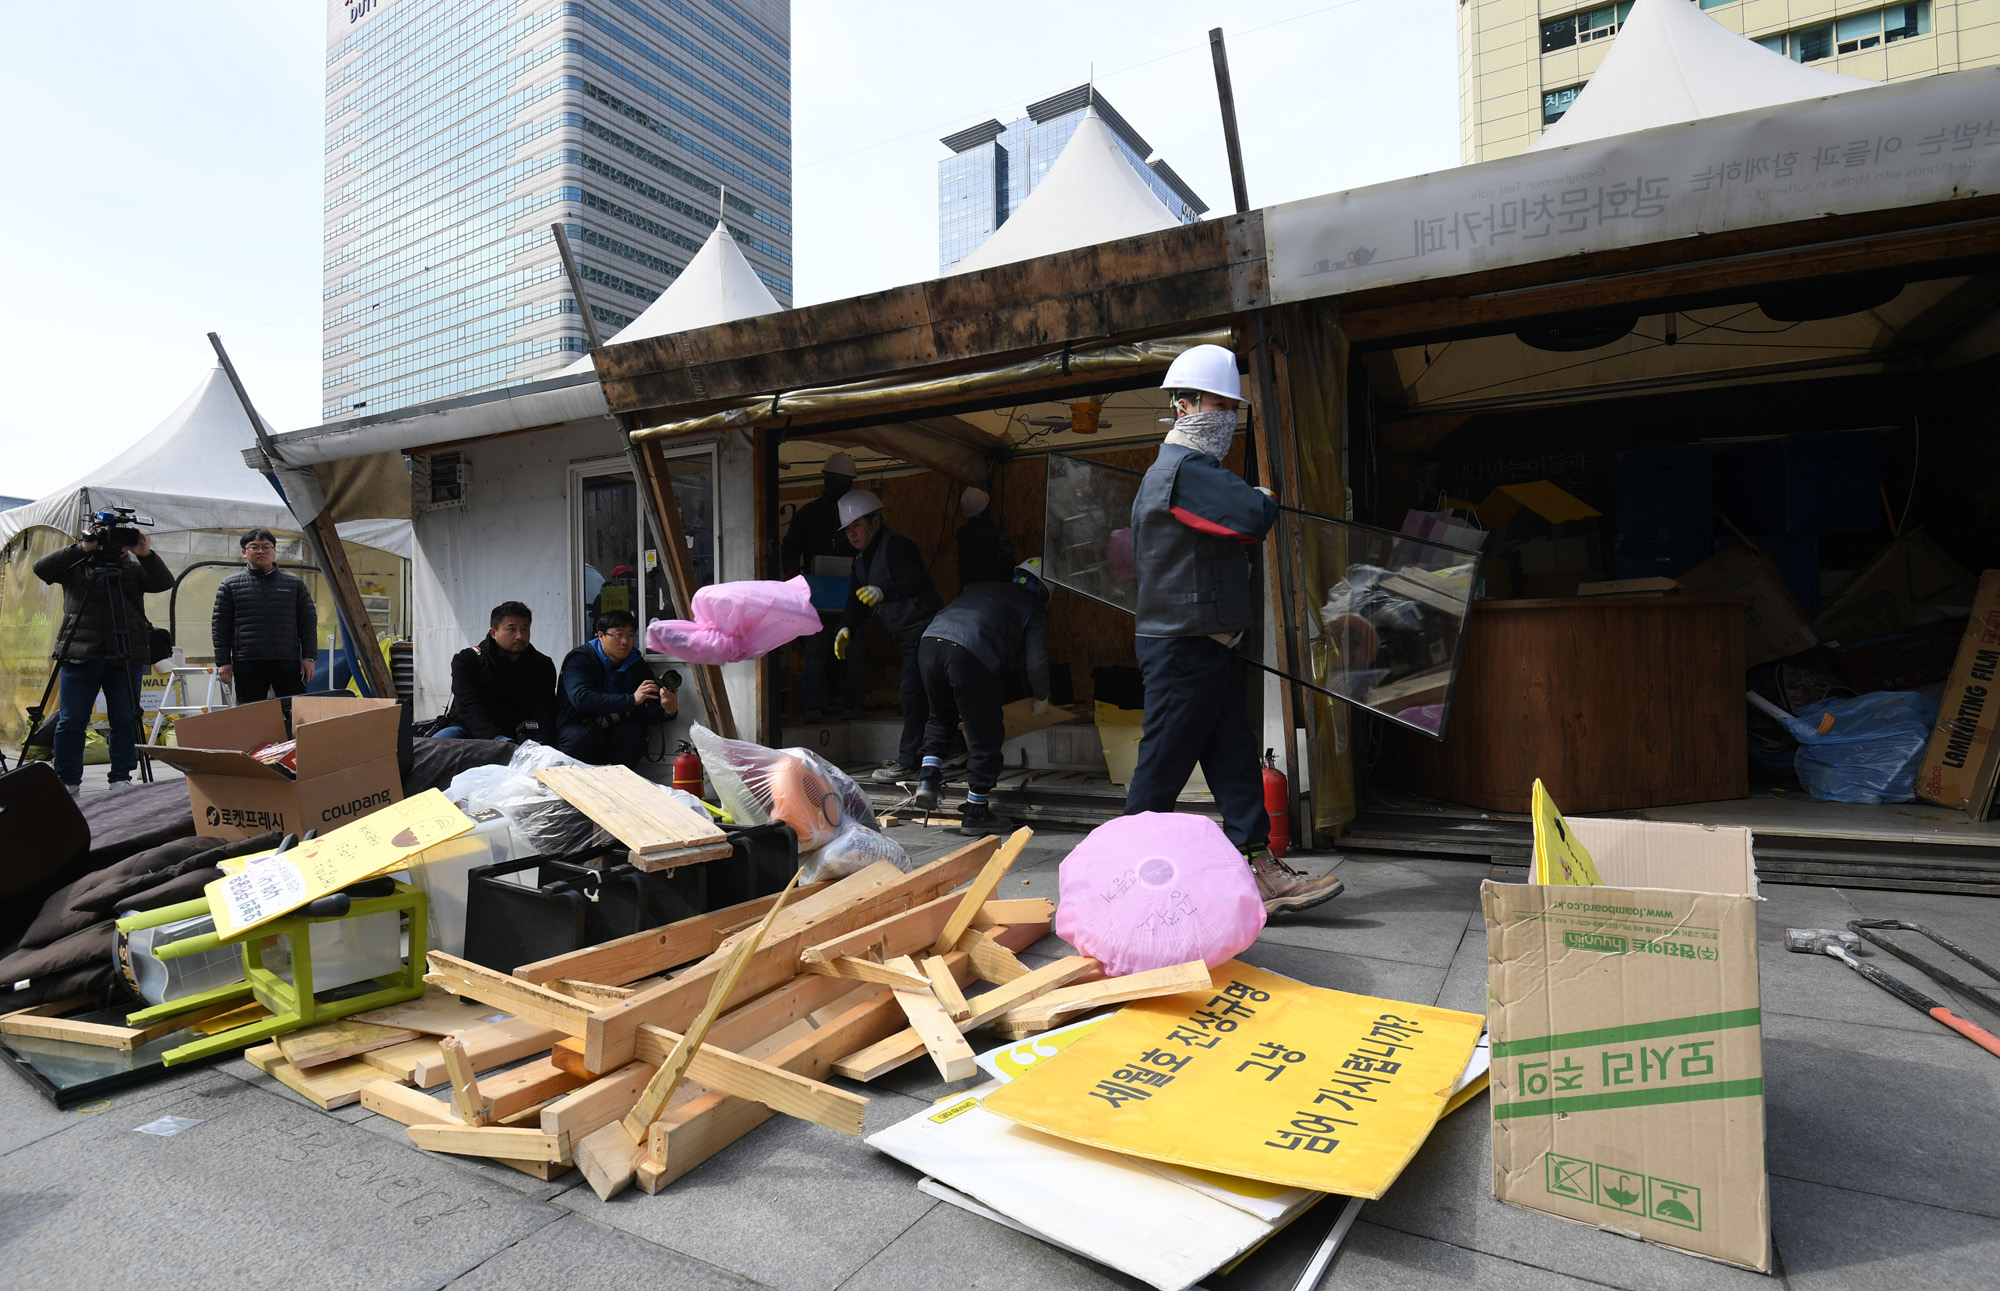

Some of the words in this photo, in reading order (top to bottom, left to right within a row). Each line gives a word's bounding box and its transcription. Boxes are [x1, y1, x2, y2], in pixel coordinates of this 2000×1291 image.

[1545, 88, 1576, 108] 치과
[1971, 649, 2000, 682] FILM
[221, 808, 284, 831] 로켓프레시
[321, 788, 391, 822] coupang
[1554, 900, 1673, 919] www.foamboard.co.kr
[1568, 932, 1622, 951] hyunjin
[1088, 1048, 1193, 1108] 세월호
[1166, 980, 1271, 1049] 진상규명
[1235, 1042, 1306, 1082] 그냥
[1518, 1056, 1584, 1096] 주의
[1601, 1040, 1715, 1087] 모서리
[1264, 1111, 1359, 1154] 넘어
[1313, 1014, 1424, 1111] 가시렵니까?
